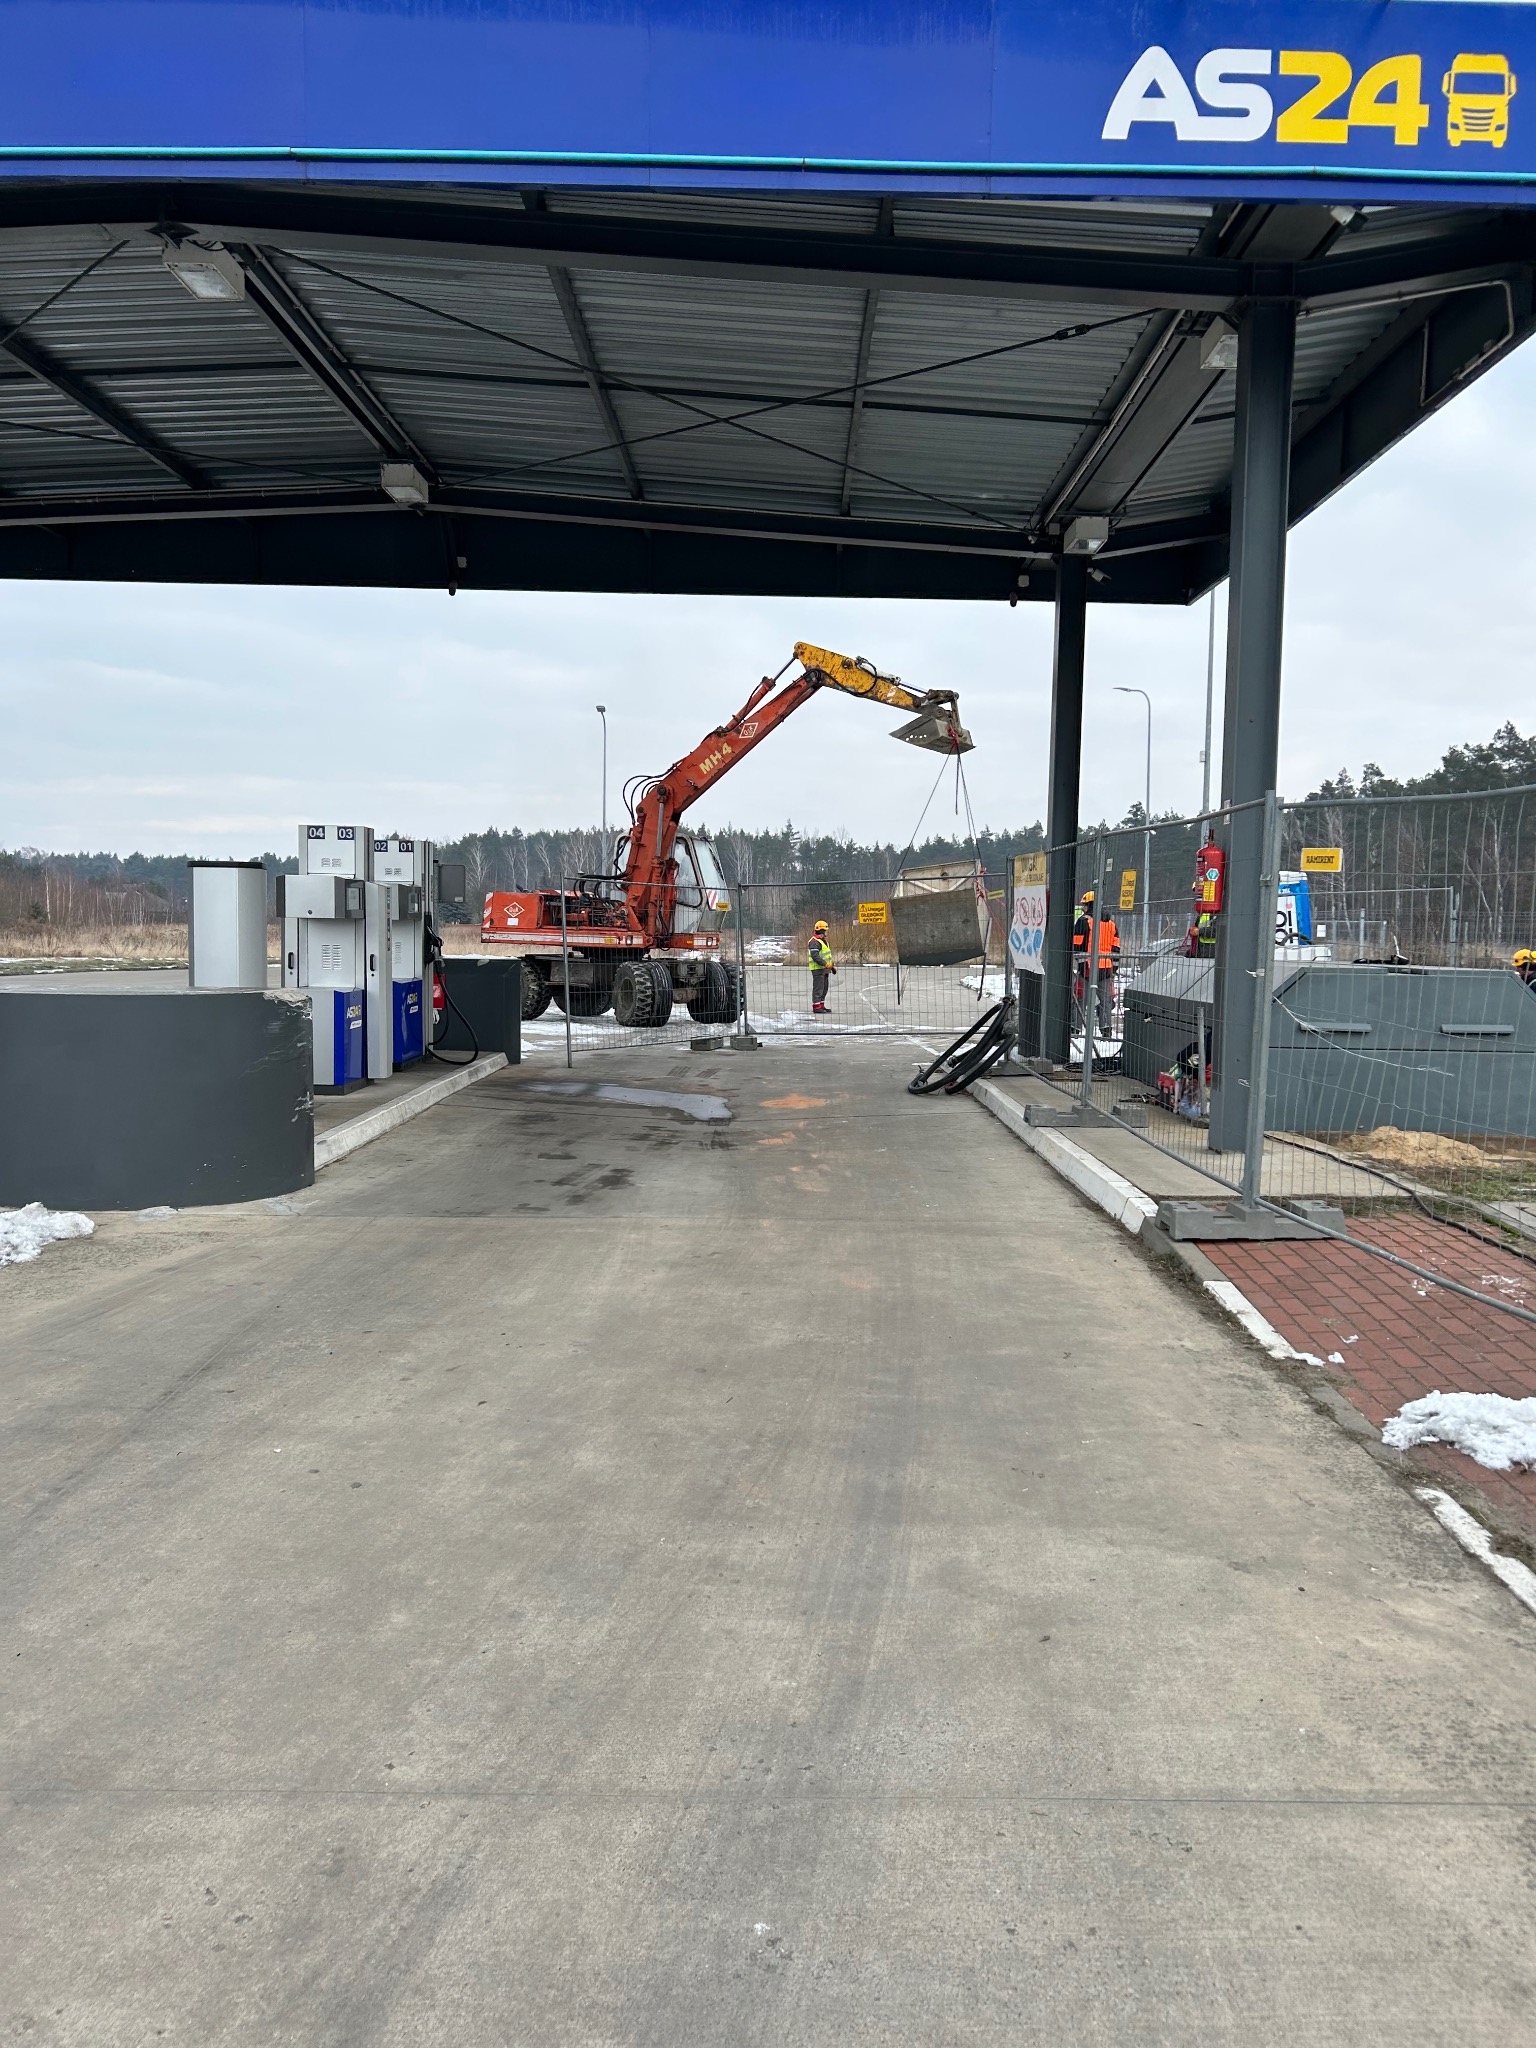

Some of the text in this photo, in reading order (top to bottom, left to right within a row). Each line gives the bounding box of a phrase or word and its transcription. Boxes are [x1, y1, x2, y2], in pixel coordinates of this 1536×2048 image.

[1102, 46, 1429, 145] AS24
[309, 827, 325, 838] 04
[338, 828, 353, 839] 03
[374, 842, 387, 851] 02
[400, 842, 413, 852] 01
